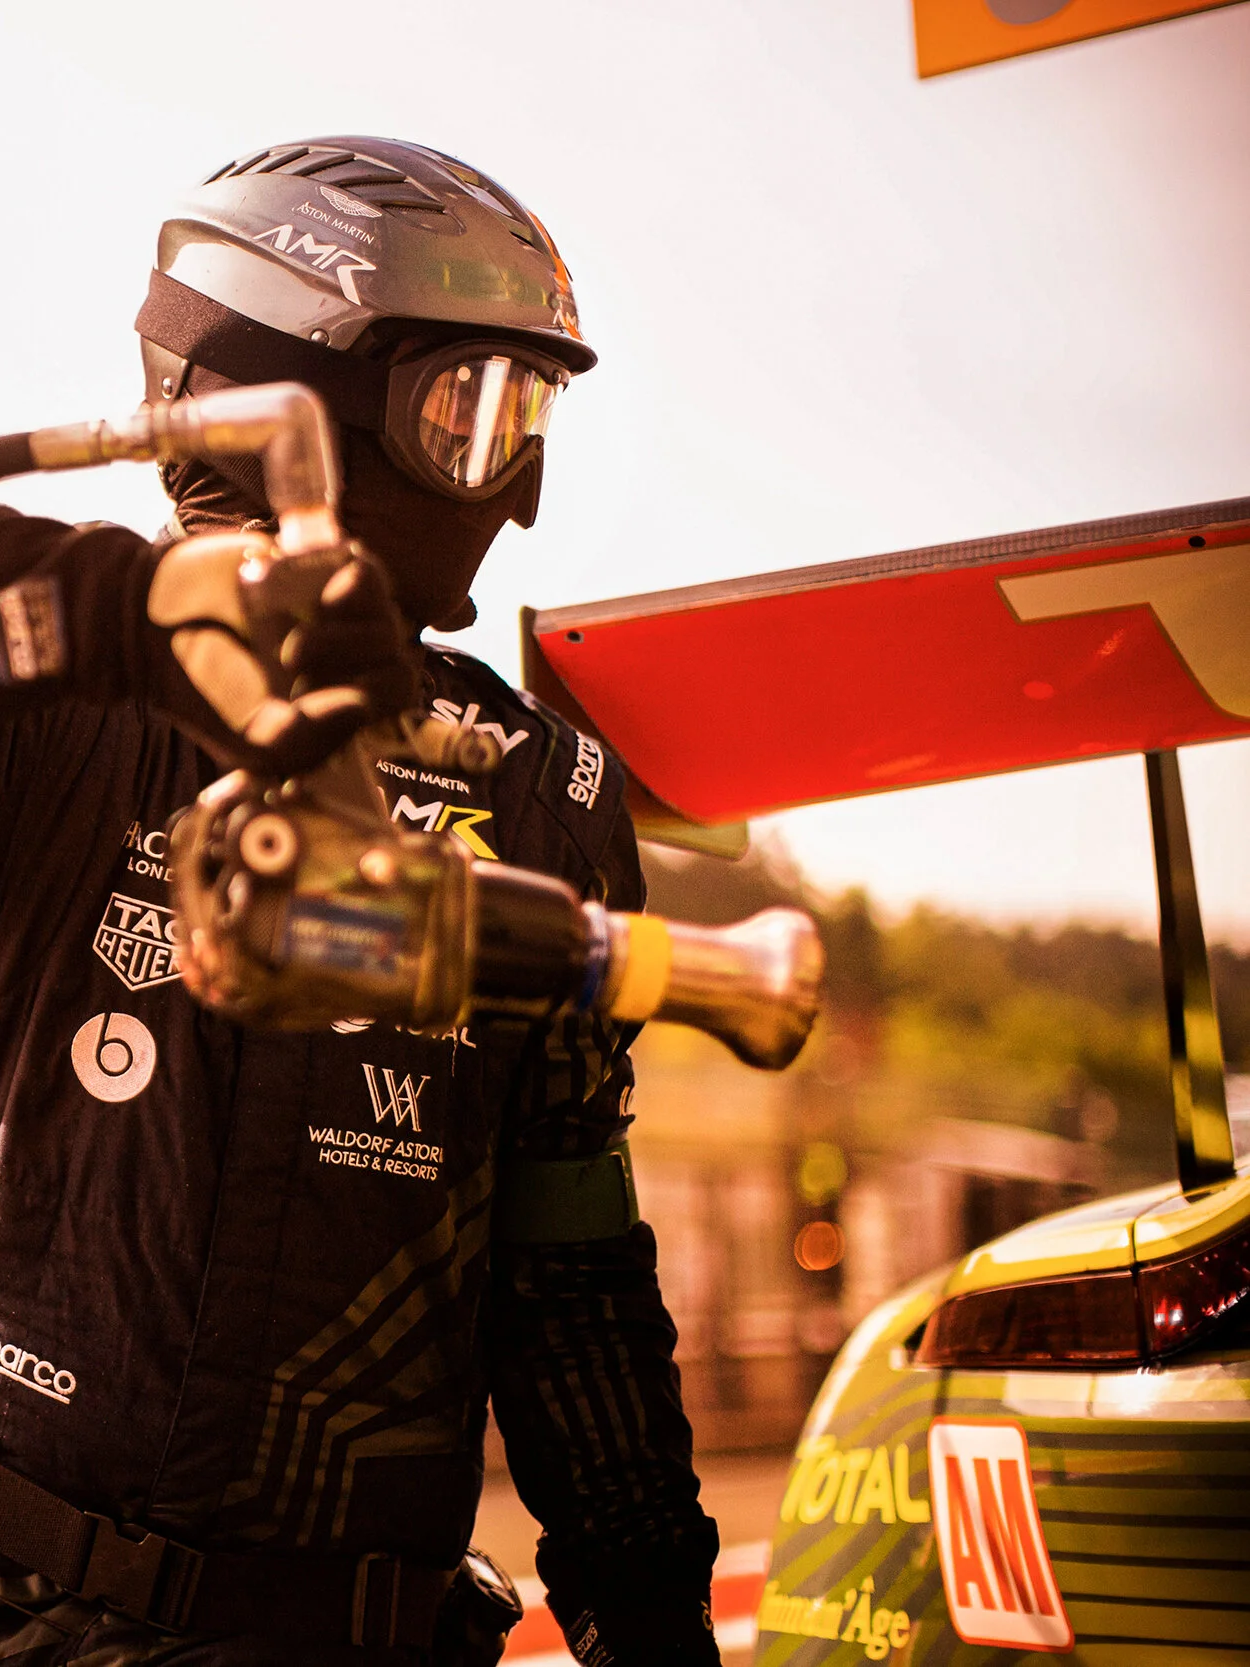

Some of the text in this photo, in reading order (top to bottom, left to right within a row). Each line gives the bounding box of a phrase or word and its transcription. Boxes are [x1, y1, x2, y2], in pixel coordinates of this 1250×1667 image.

[296, 203, 375, 245] ASTON MARTIN
[252, 224, 377, 306] AMR
[376, 759, 471, 795] ASTON MARTIN
[377, 786, 499, 861] MR
[308, 1125, 444, 1164] WALDORF ASTORI
[319, 1148, 439, 1182] HOTELS & RESORTS
[780, 1434, 932, 1524] TOTAL
[945, 1455, 1059, 1618] AM
